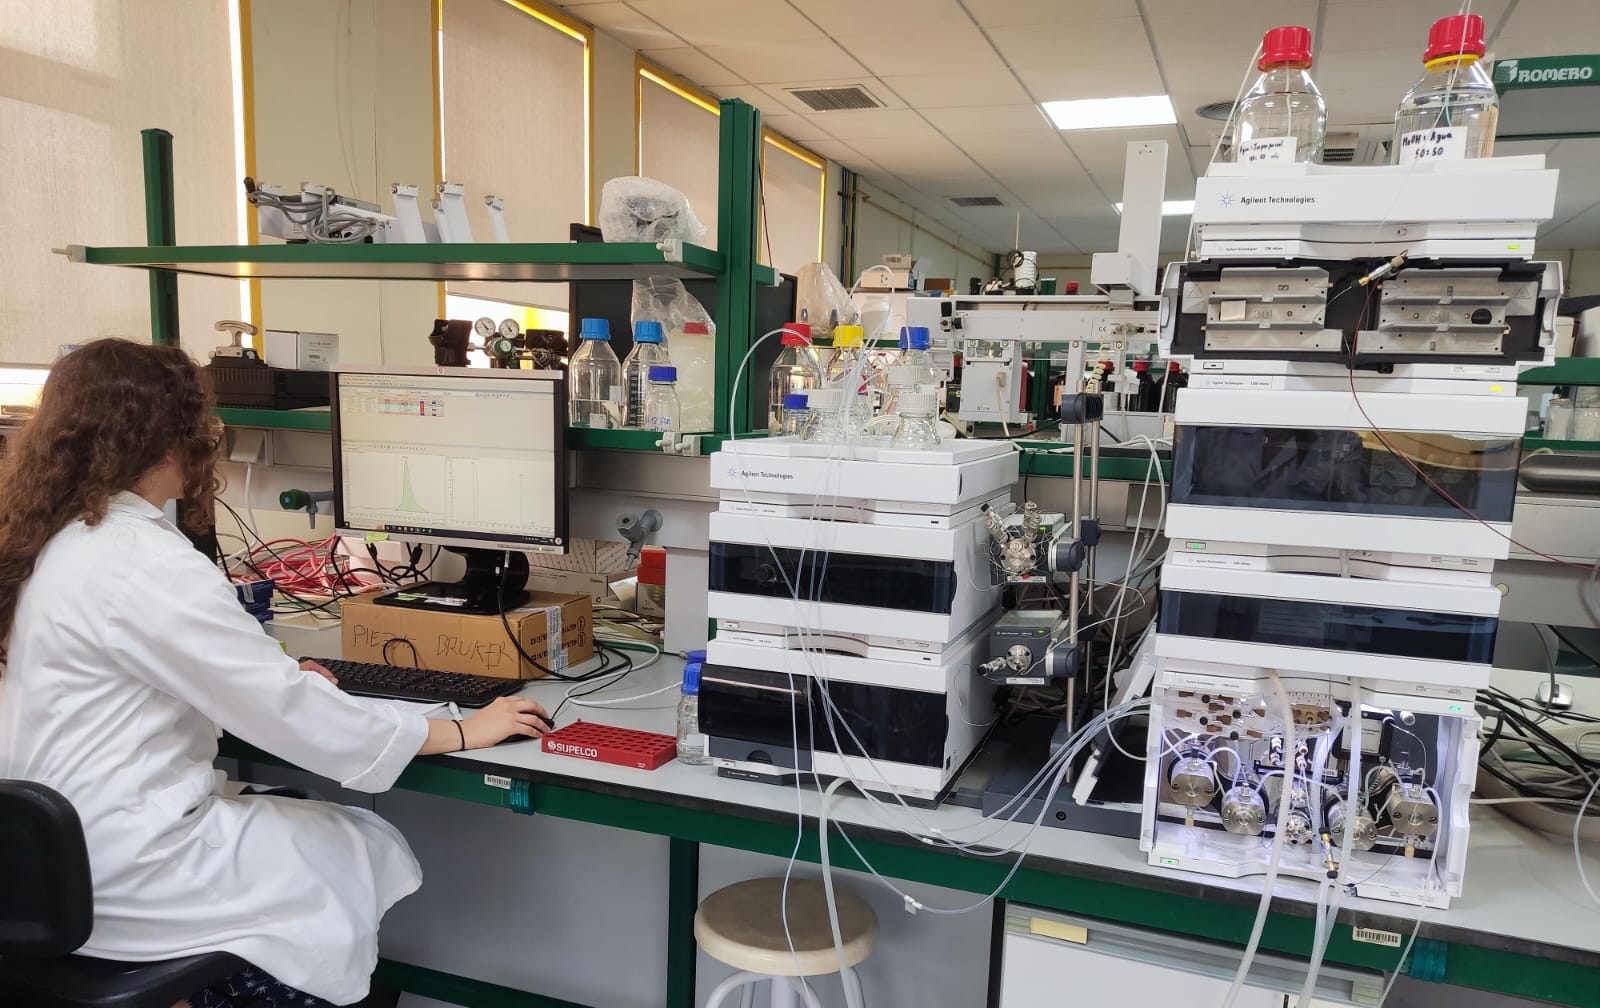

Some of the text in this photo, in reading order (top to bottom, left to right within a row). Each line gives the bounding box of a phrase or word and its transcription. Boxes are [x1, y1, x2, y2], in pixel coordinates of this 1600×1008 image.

[1518, 66, 1593, 82] ROMERO
[1430, 131, 1452, 143] Agua
[1240, 196, 1315, 205] Agilent Technologies
[741, 470, 793, 480] Agilent Technologies
[556, 742, 598, 758] SUPELCO
